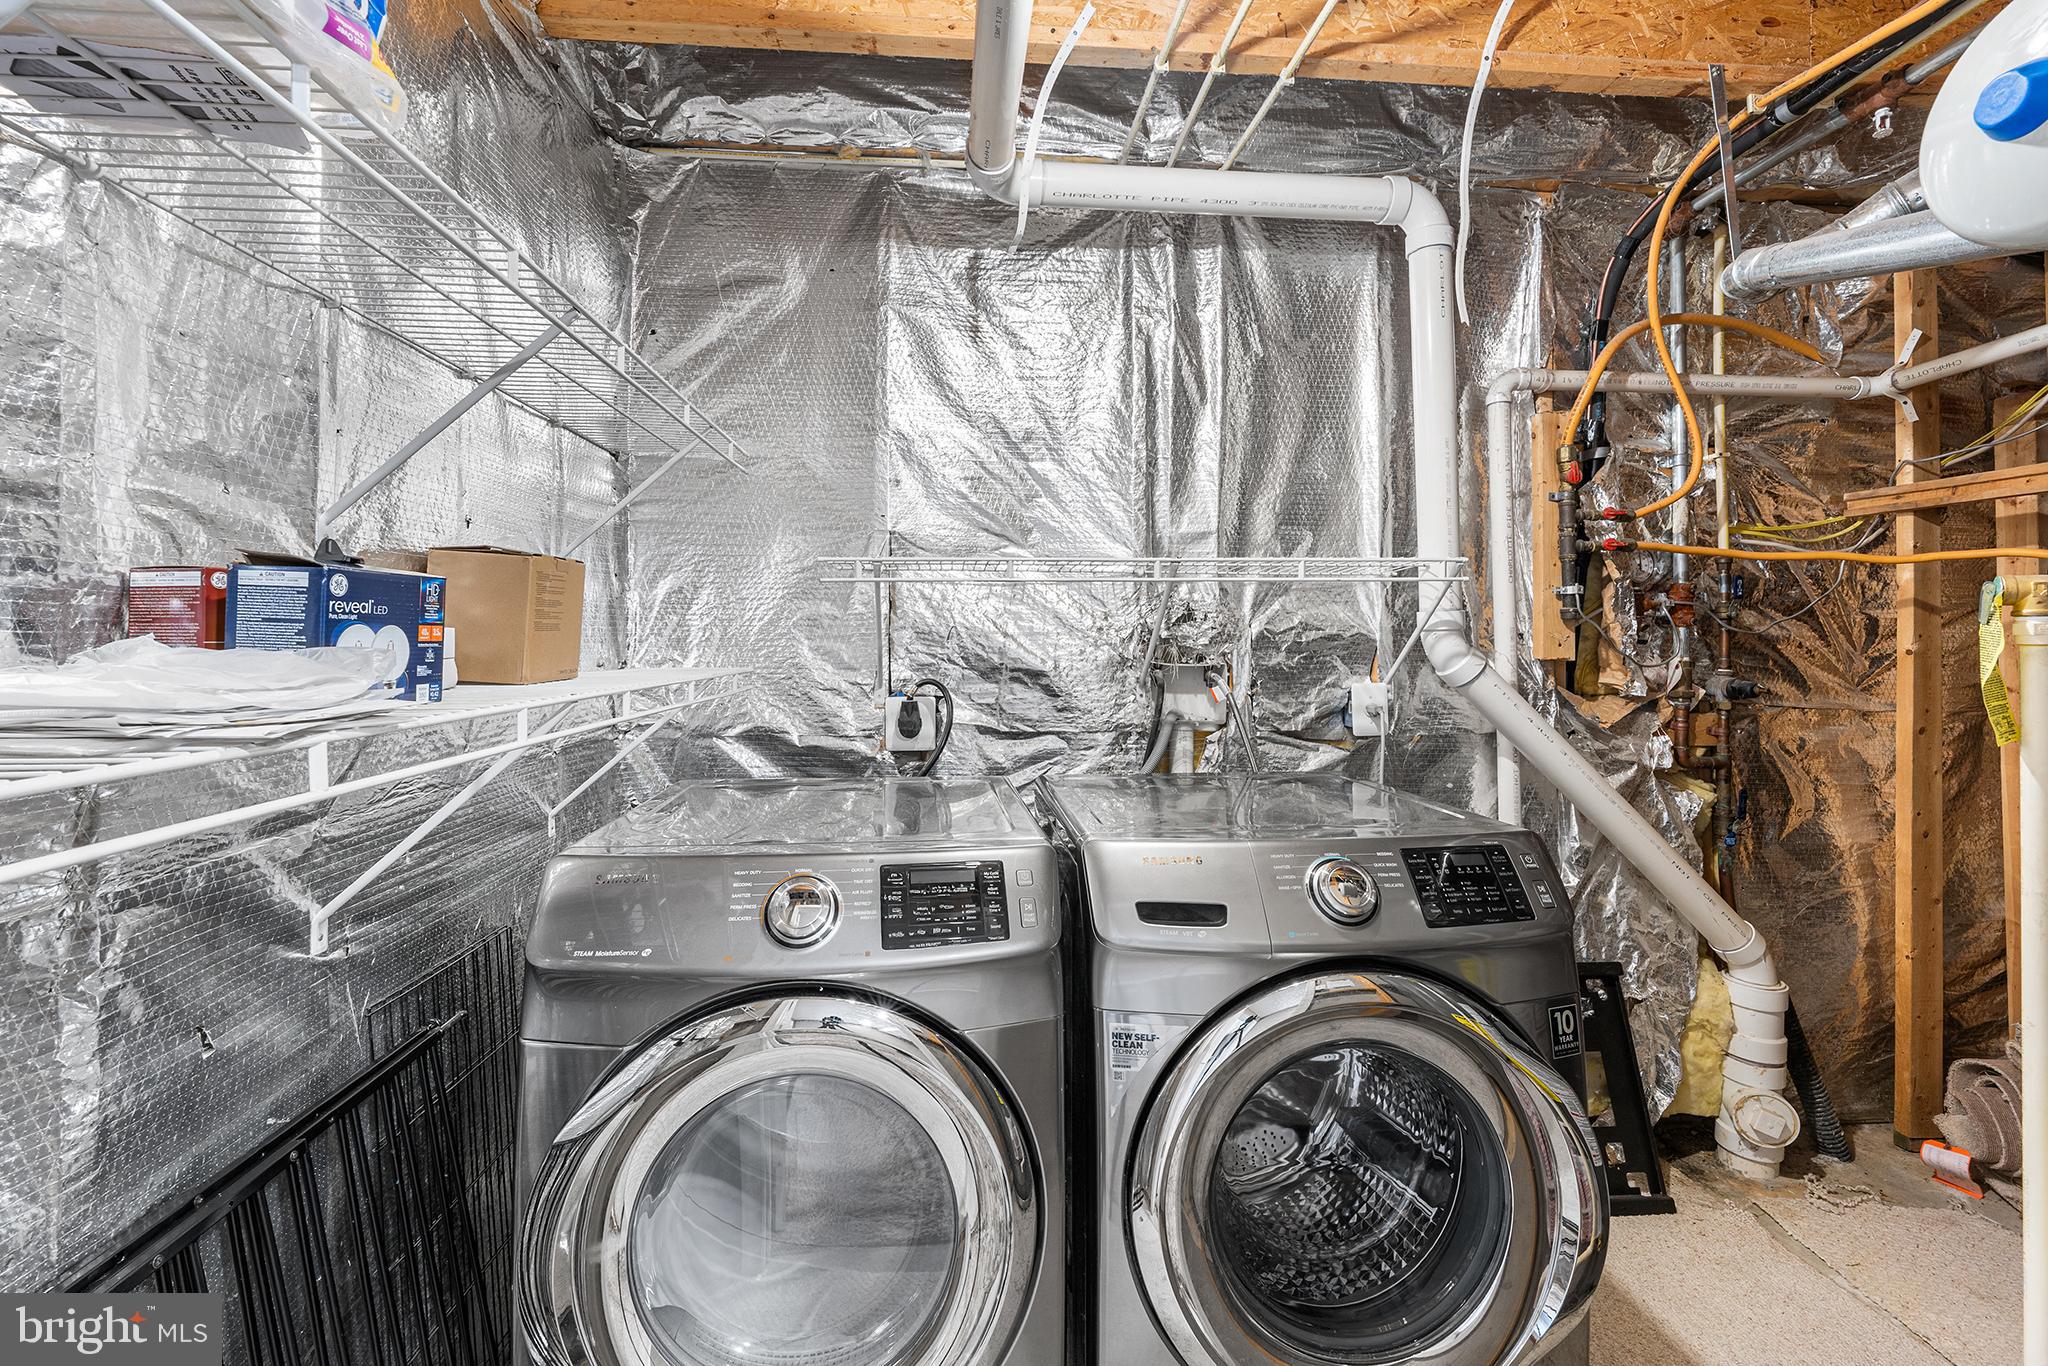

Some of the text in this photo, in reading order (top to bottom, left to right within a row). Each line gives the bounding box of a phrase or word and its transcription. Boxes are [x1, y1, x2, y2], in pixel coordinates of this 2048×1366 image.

[1053, 191, 1143, 201] CHARLOTTE
[1151, 196, 1192, 204] PIPE
[1506, 535, 1514, 584] CHARLOTTE
[426, 583, 440, 596] HD
[373, 605, 389, 615] LED
[1672, 860, 1690, 879] NOT
[595, 949, 640, 957] MoistureSensor
[1553, 1009, 1575, 1035] 10
[1111, 1031, 1160, 1042] NEW SELF-
[1558, 1034, 1574, 1043] YEAR
[1111, 1040, 1143, 1049] CLEAN
[1554, 1041, 1579, 1051] WARRANTY
[1112, 1048, 1150, 1056] TECHNOLOGY
